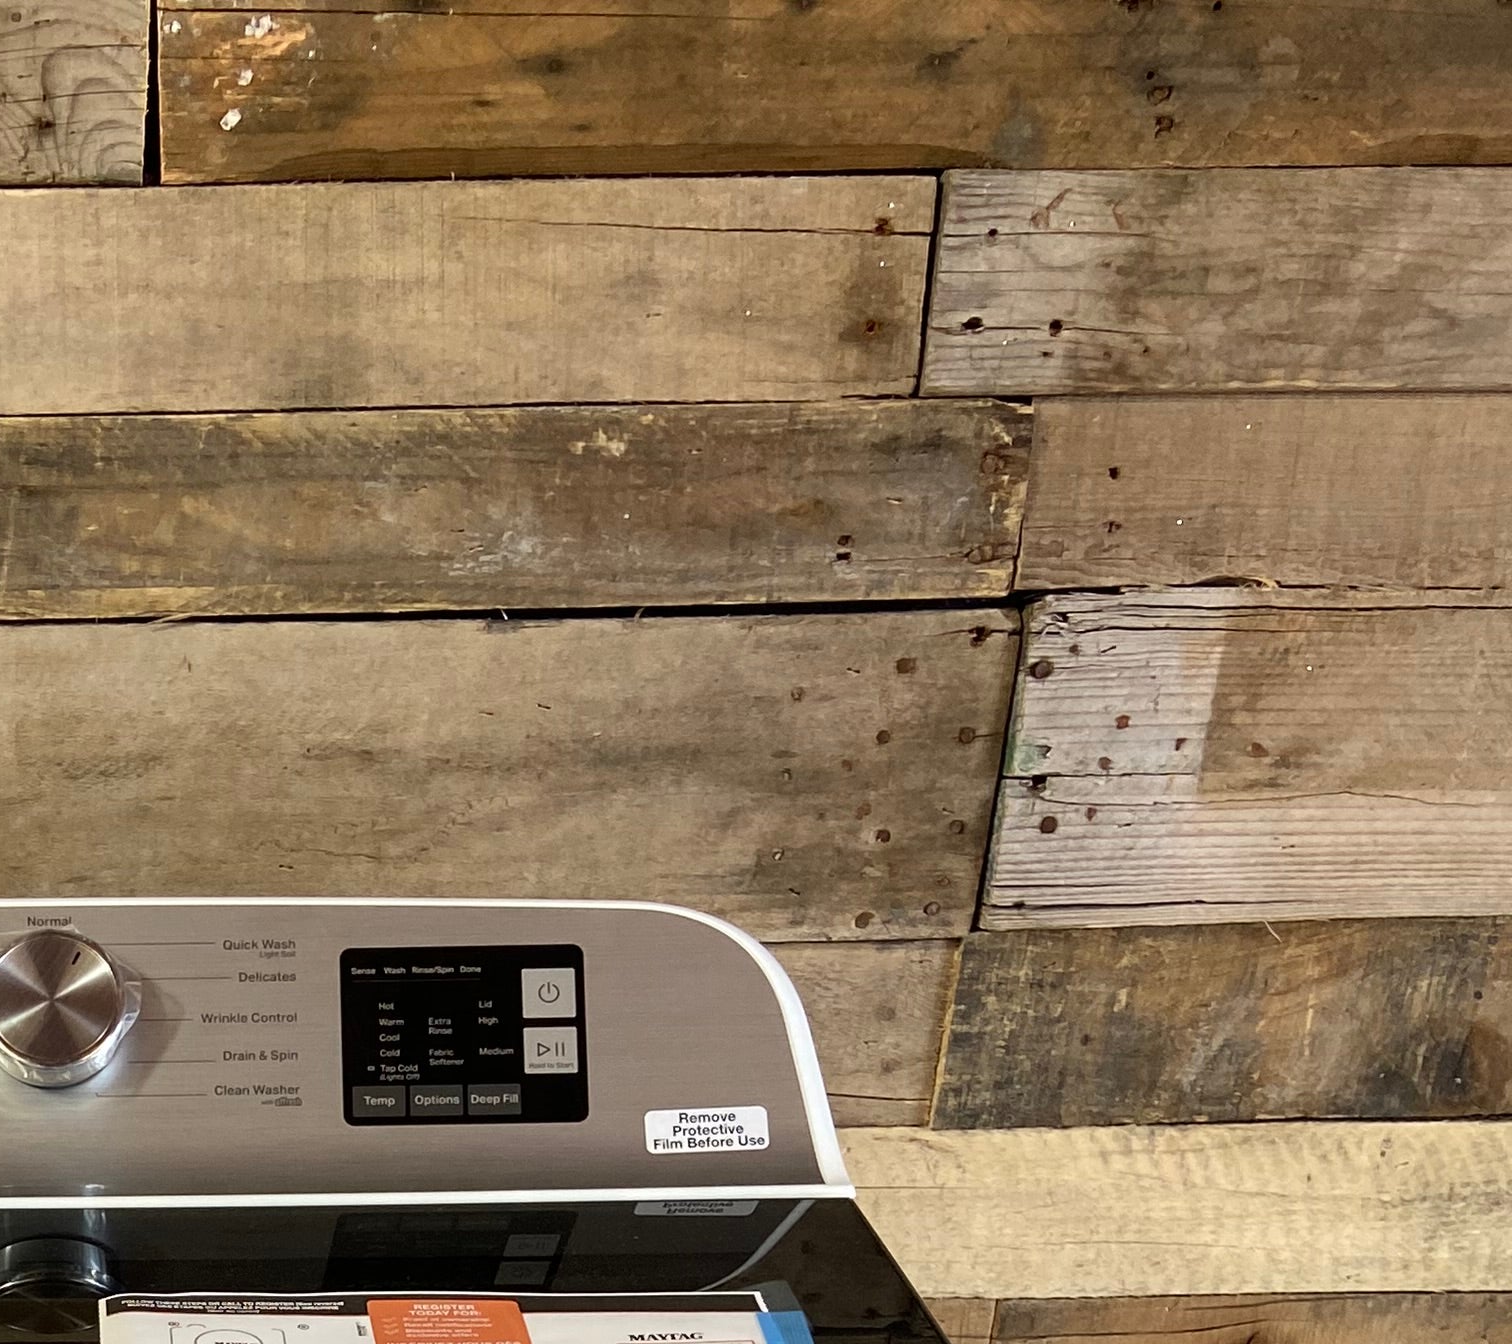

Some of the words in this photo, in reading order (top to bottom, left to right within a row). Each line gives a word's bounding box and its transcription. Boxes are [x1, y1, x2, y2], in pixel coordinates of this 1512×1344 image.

[26, 916, 72, 928] Normal
[222, 940, 258, 951] Quick
[262, 939, 296, 949] Wash
[350, 967, 376, 975] Sense
[383, 966, 406, 974] Wash
[411, 965, 454, 974] Rinse/Spin
[459, 965, 481, 973] Done
[238, 972, 296, 982] Delicates
[378, 1002, 394, 1010] Hot
[478, 1000, 493, 1008] Lid
[200, 1013, 248, 1023] Wrinkle
[251, 1012, 297, 1023] Control
[378, 1018, 404, 1026] Warm
[428, 1017, 451, 1026] Extra
[478, 1016, 499, 1026] High
[428, 1026, 452, 1035] Rinse
[378, 1033, 400, 1042] Cool
[222, 1050, 257, 1061] Drain
[259, 1051, 267, 1060] &
[270, 1050, 298, 1062] Spin
[379, 1048, 400, 1057] Cold
[429, 1048, 454, 1056] Fabric
[478, 1047, 514, 1055] Medium
[380, 1064, 396, 1074] Tap
[397, 1064, 419, 1073] Cold
[214, 1085, 250, 1096] Clean
[253, 1084, 300, 1095] Washer
[364, 1095, 396, 1107] Temp
[414, 1094, 460, 1106] Options
[470, 1094, 500, 1106] Deep
[502, 1093, 519, 1103] Fill
[678, 1112, 737, 1124] Remove
[672, 1123, 745, 1137] Protective
[653, 1138, 683, 1151] Film
[687, 1136, 734, 1149] Before
[737, 1135, 766, 1147] Use
[413, 1303, 476, 1311] REGISTER
[628, 1332, 705, 1342] MAYTAG
